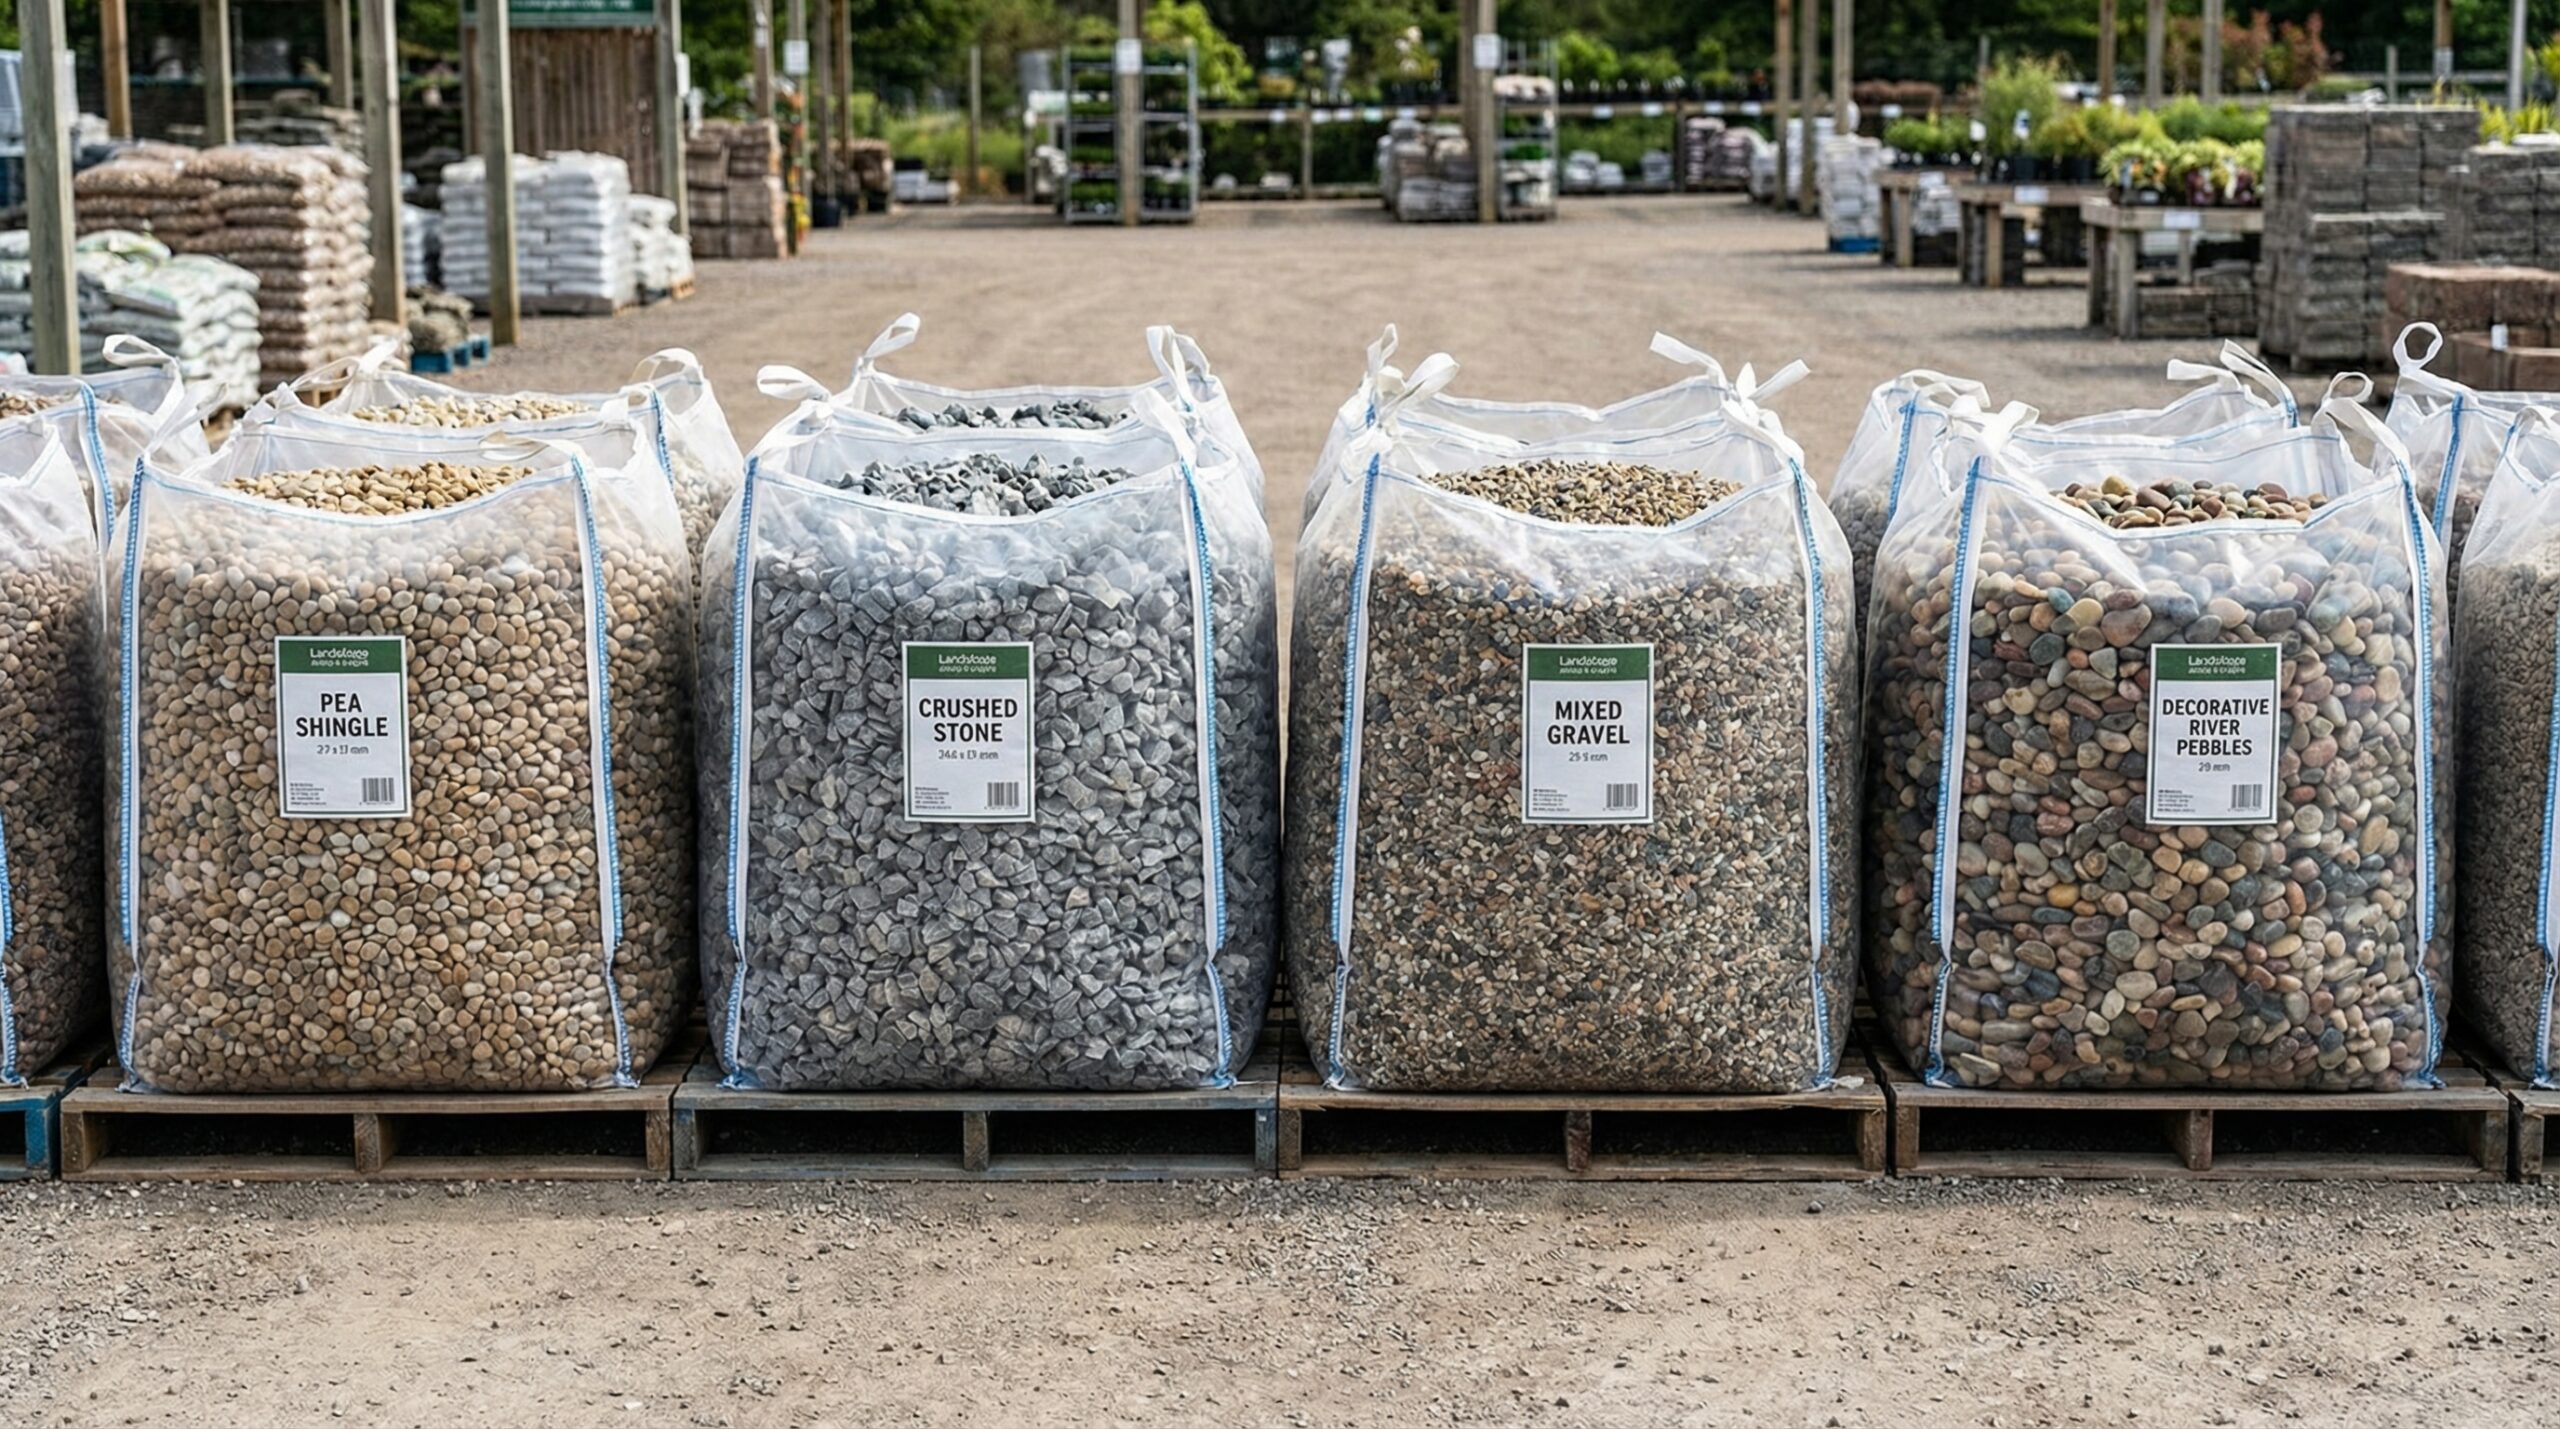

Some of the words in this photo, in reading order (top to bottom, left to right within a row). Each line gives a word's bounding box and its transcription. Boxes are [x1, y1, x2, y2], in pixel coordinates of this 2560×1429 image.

[320, 693, 362, 713] PEA
[919, 698, 1018, 718] CRUSHED
[1555, 700, 1622, 720] MIXED
[2162, 698, 2270, 716] DECORATIVE
[296, 717, 388, 737] SHINGLE
[934, 722, 1003, 742] STONE
[1547, 725, 1630, 745] GRAVEL
[2189, 719, 2240, 736] RIVER
[2177, 739, 2252, 756] PEBBLES
